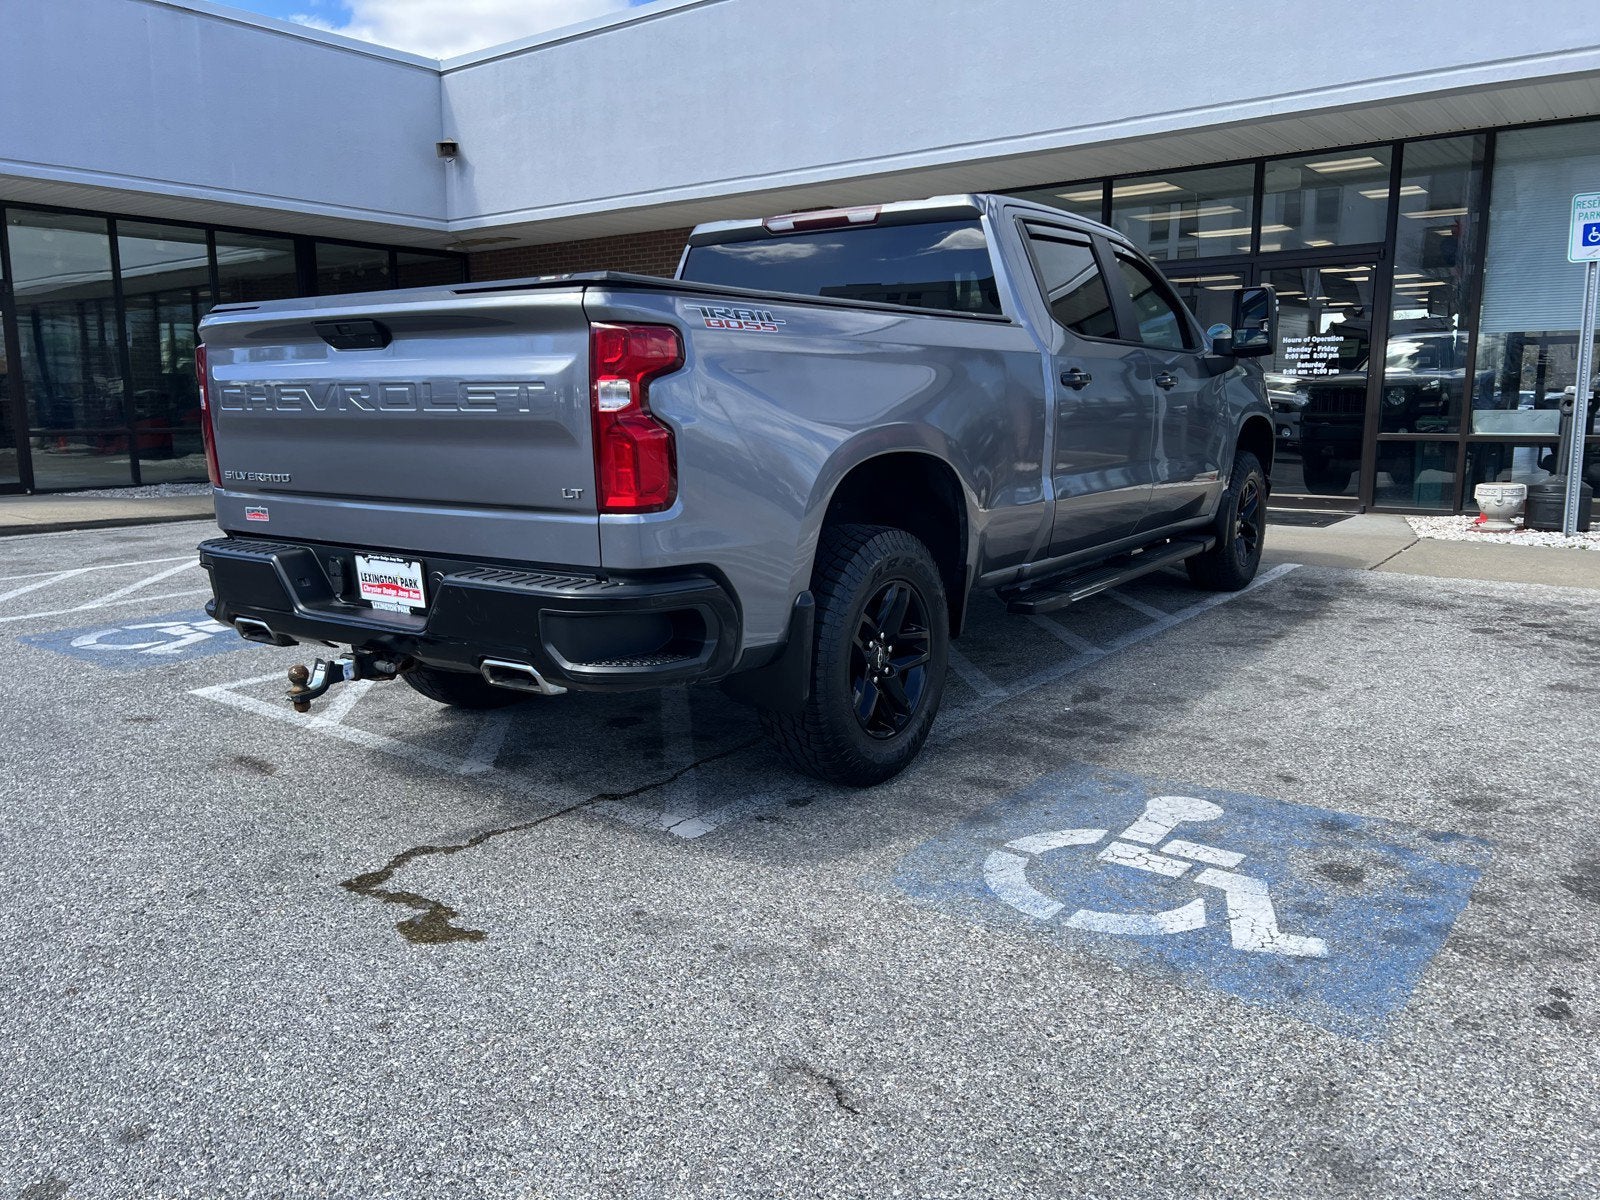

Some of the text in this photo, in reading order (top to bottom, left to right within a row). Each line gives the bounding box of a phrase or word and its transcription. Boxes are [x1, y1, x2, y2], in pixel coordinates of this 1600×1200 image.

[684, 304, 786, 325] TRAIL
[704, 318, 779, 332] BOSS
[1311, 335, 1344, 343] Operation
[218, 381, 547, 413] CHEVROLET
[224, 470, 292, 484] SILVERADO
[561, 487, 584, 500] LT
[360, 572, 419, 589] LEXINGTON PARK
[364, 585, 383, 594] Chrysler
[383, 587, 397, 597] Dodge
[398, 590, 409, 598] Jeep
